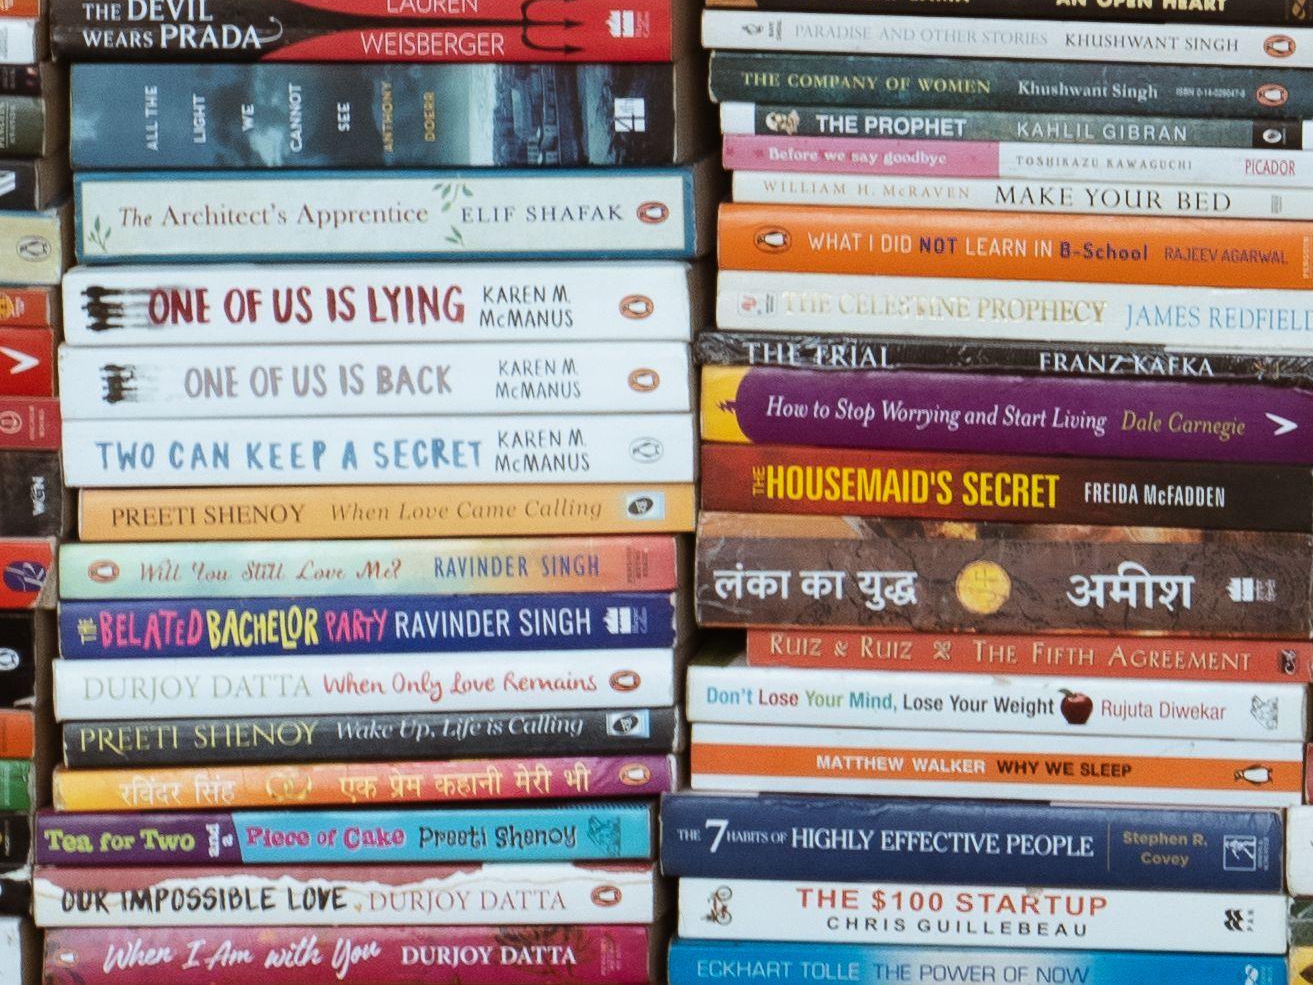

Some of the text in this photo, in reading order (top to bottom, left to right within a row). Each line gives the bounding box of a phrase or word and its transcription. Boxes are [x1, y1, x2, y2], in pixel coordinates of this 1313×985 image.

[360, 31, 504, 56] WEISBERGER
[1245, 158, 1296, 176] PICADOR
[1122, 410, 1246, 439] Dale Carnegie
[1084, 481, 1225, 507] FREIDA McFADDEN
[816, 754, 985, 774] MATTHEW WALKER
[997, 759, 1132, 778] WHY WE SLEEP
[338, 762, 590, 803] एक प्रेम कहानी मेरी भी
[826, 916, 1087, 937] CHRIS GUILLEBEAU
[401, 945, 576, 967] DURJOY DATTA
